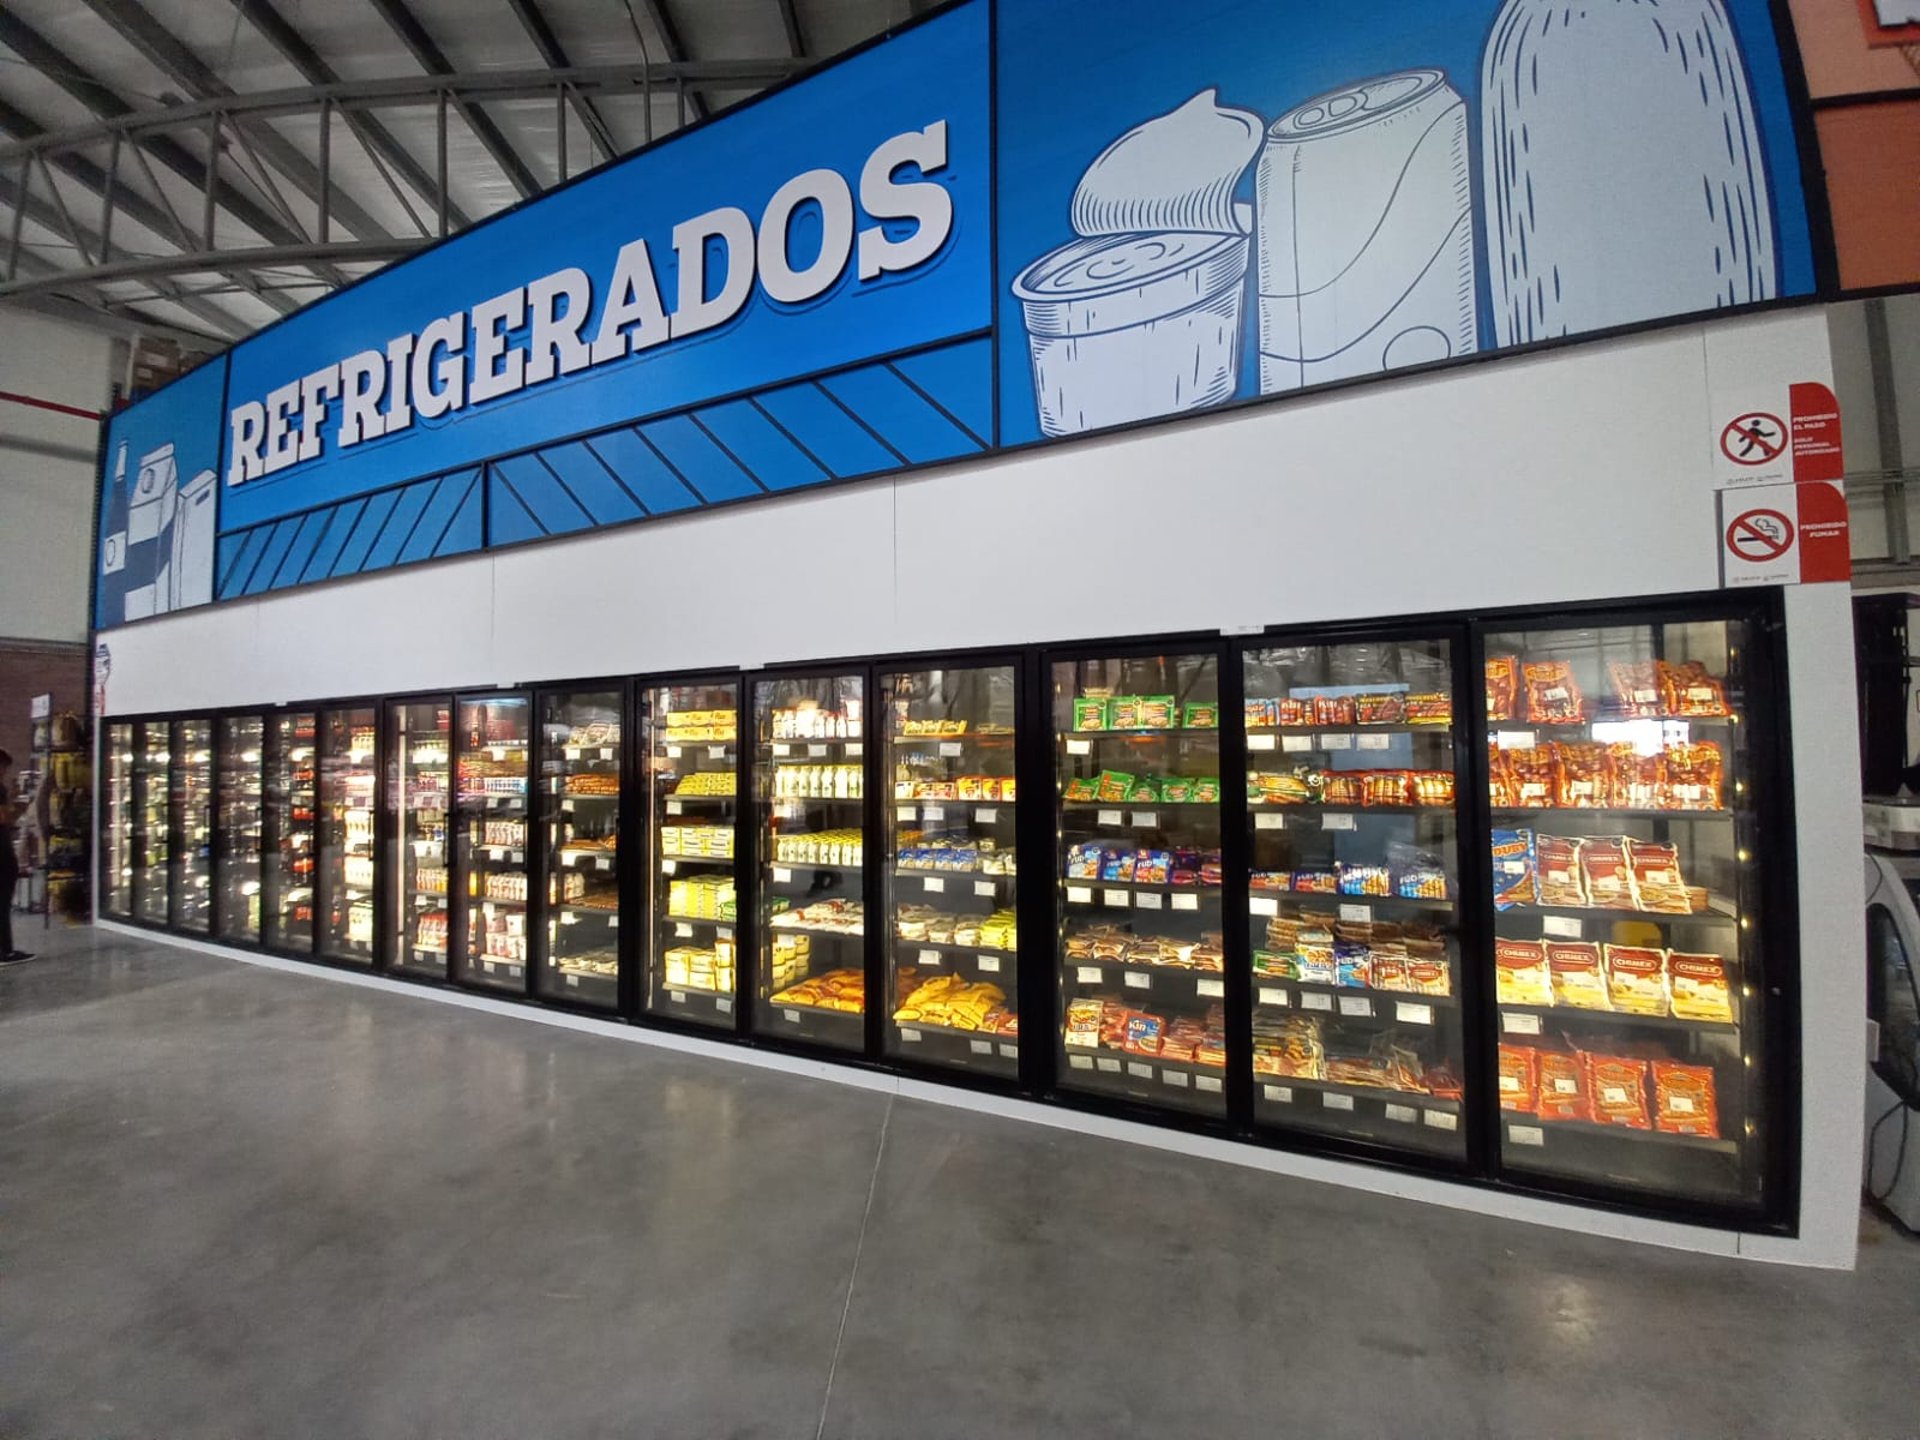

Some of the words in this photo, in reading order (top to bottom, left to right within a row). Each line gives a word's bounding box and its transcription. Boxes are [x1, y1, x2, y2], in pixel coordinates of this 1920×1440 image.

[226, 119, 954, 486] REFRIGERADOS
[1793, 413, 1838, 422] PROHIBIDO
[1804, 421, 1826, 429] PASO
[1794, 442, 1830, 450] PERSONAL
[1795, 447, 1840, 456] AUTORIZADO
[1800, 521, 1847, 530] PROHIBIDO
[1809, 530, 1840, 538] FUMAR
[1504, 949, 1537, 958] CHIMEX
[1555, 952, 1590, 962] CHIMEX
[1616, 957, 1652, 969] CHIMEX
[1679, 962, 1718, 973] CHIMEX
